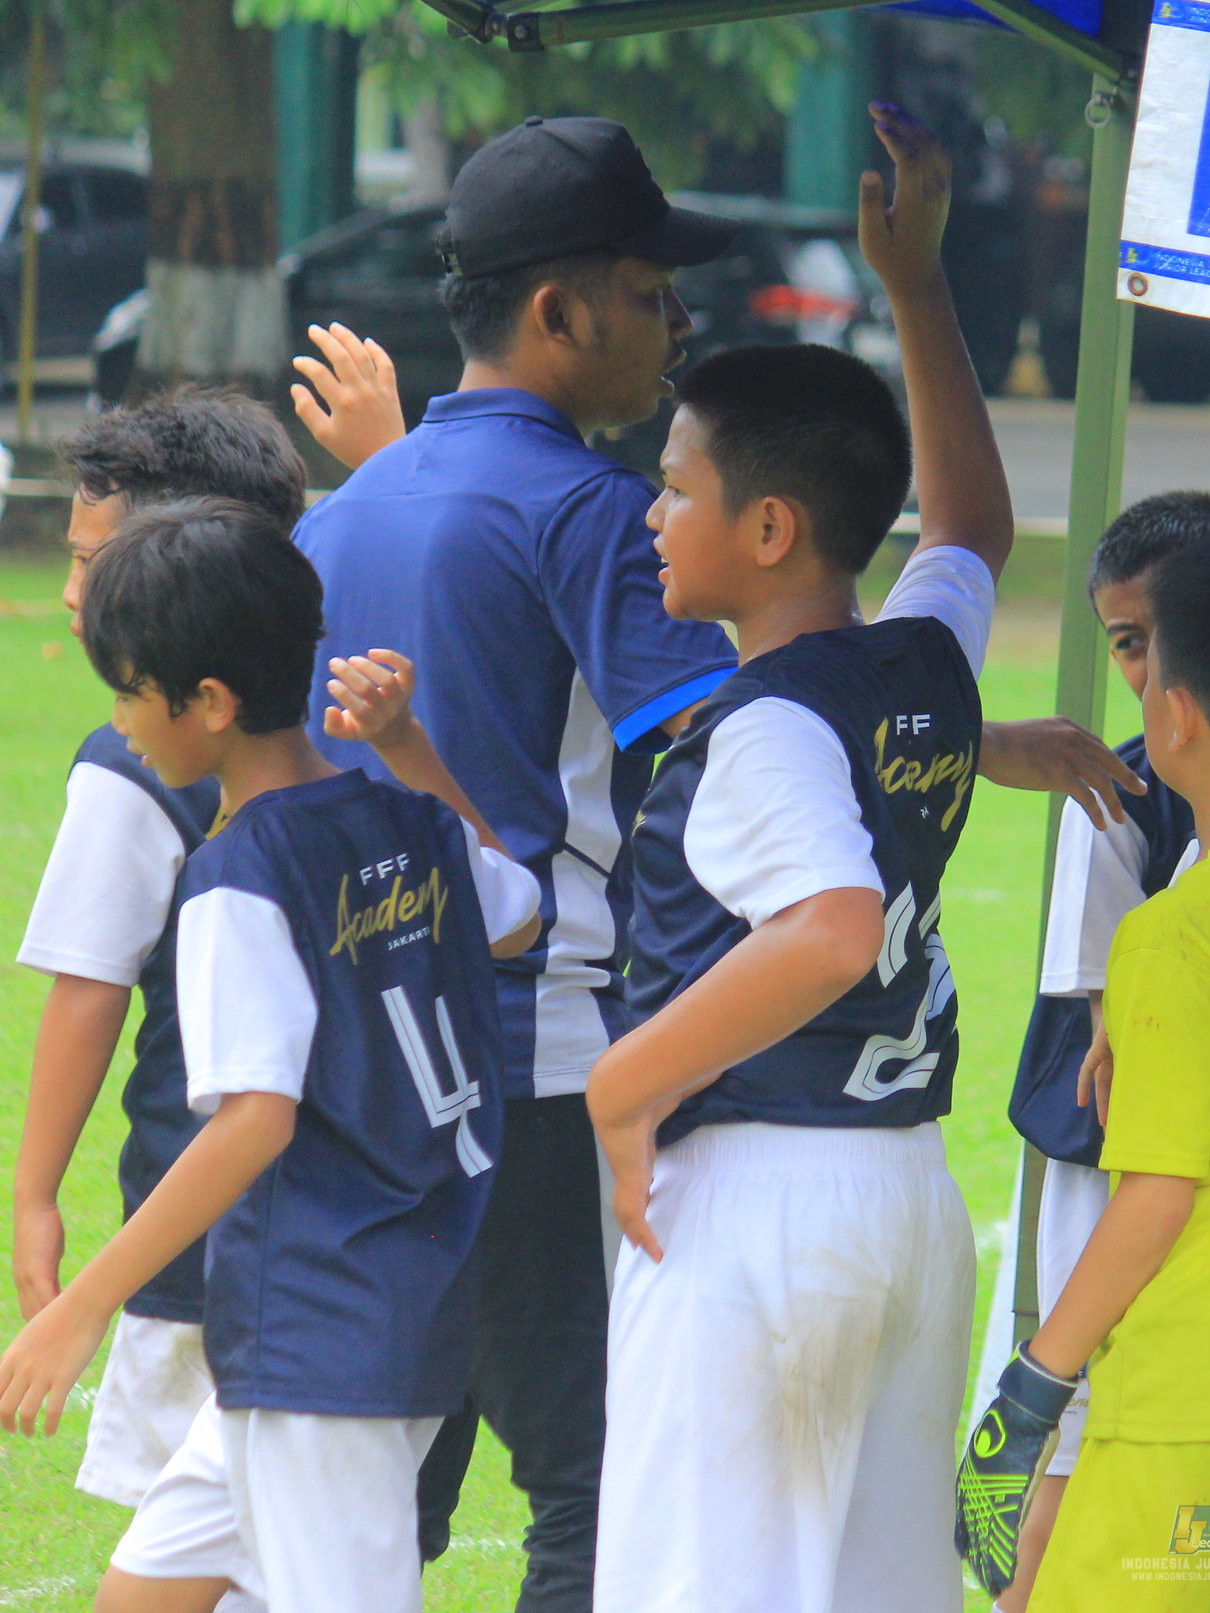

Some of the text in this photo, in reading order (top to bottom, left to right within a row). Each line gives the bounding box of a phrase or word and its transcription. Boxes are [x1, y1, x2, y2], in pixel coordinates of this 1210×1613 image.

[1154, 261, 1187, 273] JUNIOR
[1155, 251, 1204, 267] INDONESIA
[359, 852, 410, 885] FFF
[329, 867, 448, 966] Academy
[387, 925, 431, 951] JAKART
[381, 984, 494, 1179] 4
